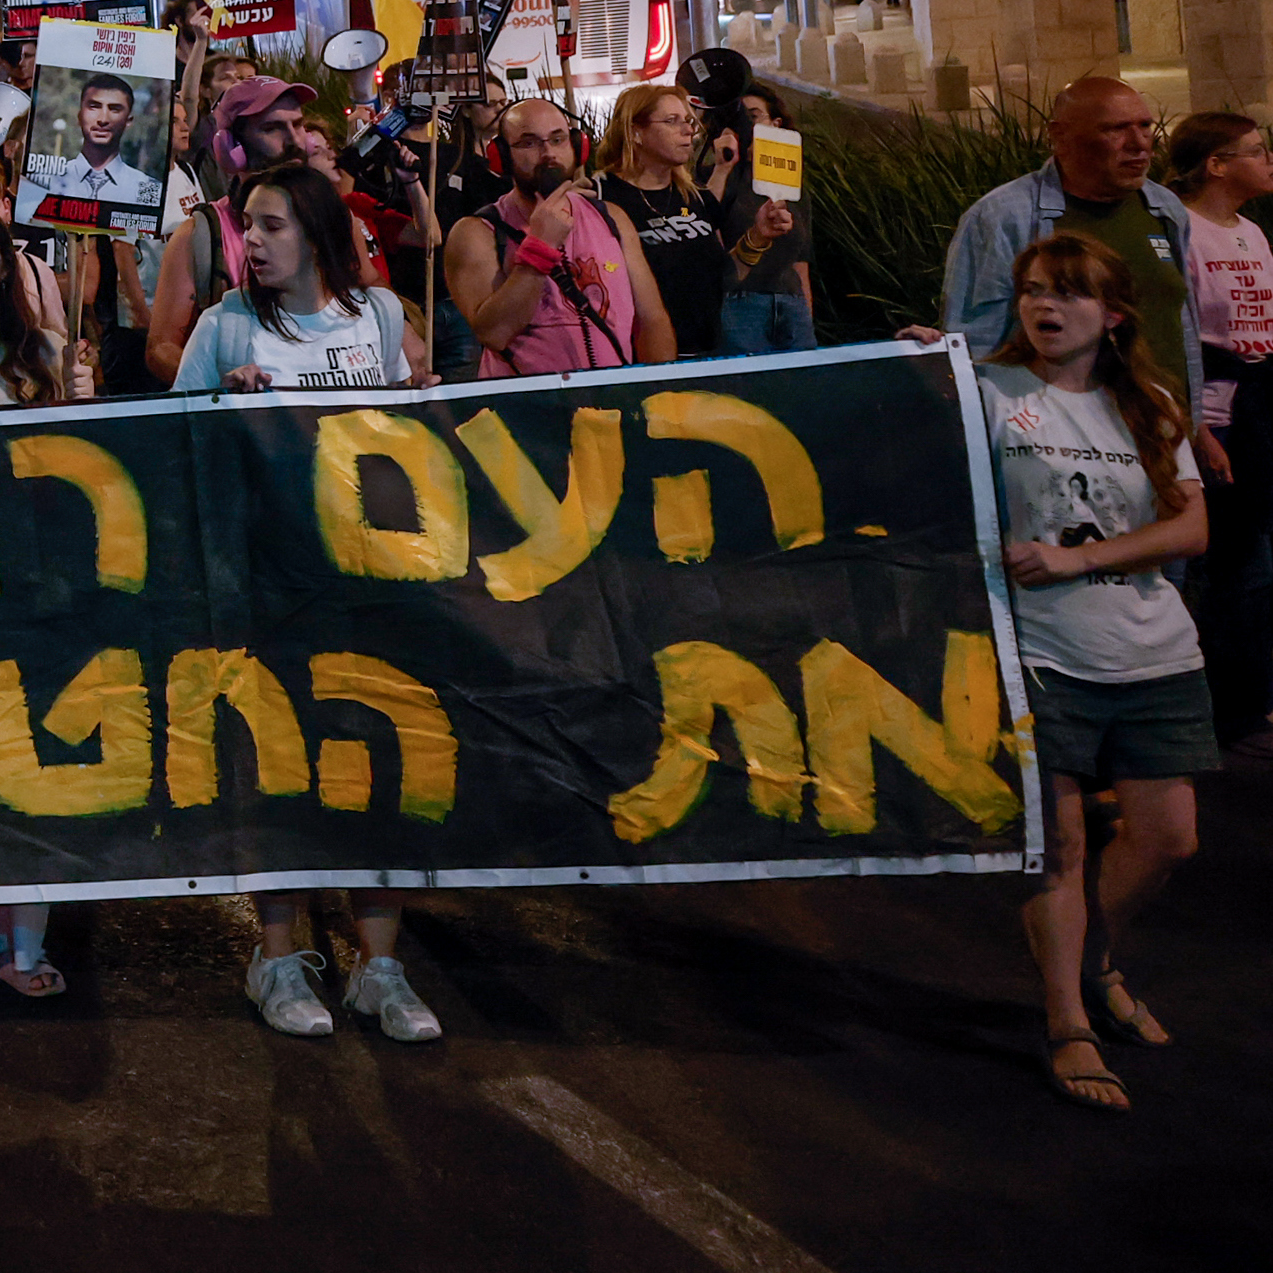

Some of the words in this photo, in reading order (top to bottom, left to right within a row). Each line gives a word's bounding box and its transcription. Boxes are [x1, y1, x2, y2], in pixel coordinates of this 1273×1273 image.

[220, 7, 274, 27] עכשיו
[93, 41, 113, 53] BIPIN
[114, 43, 136, 56] JOSHI
[92, 54, 115, 68] (24)
[26, 153, 67, 176] BRING
[1005, 442, 1055, 458] סליחה
[1059, 445, 1103, 461] לבקש
[1106, 452, 1141, 467] קום
[314, 390, 825, 604] העם
[607, 625, 1034, 847] את
